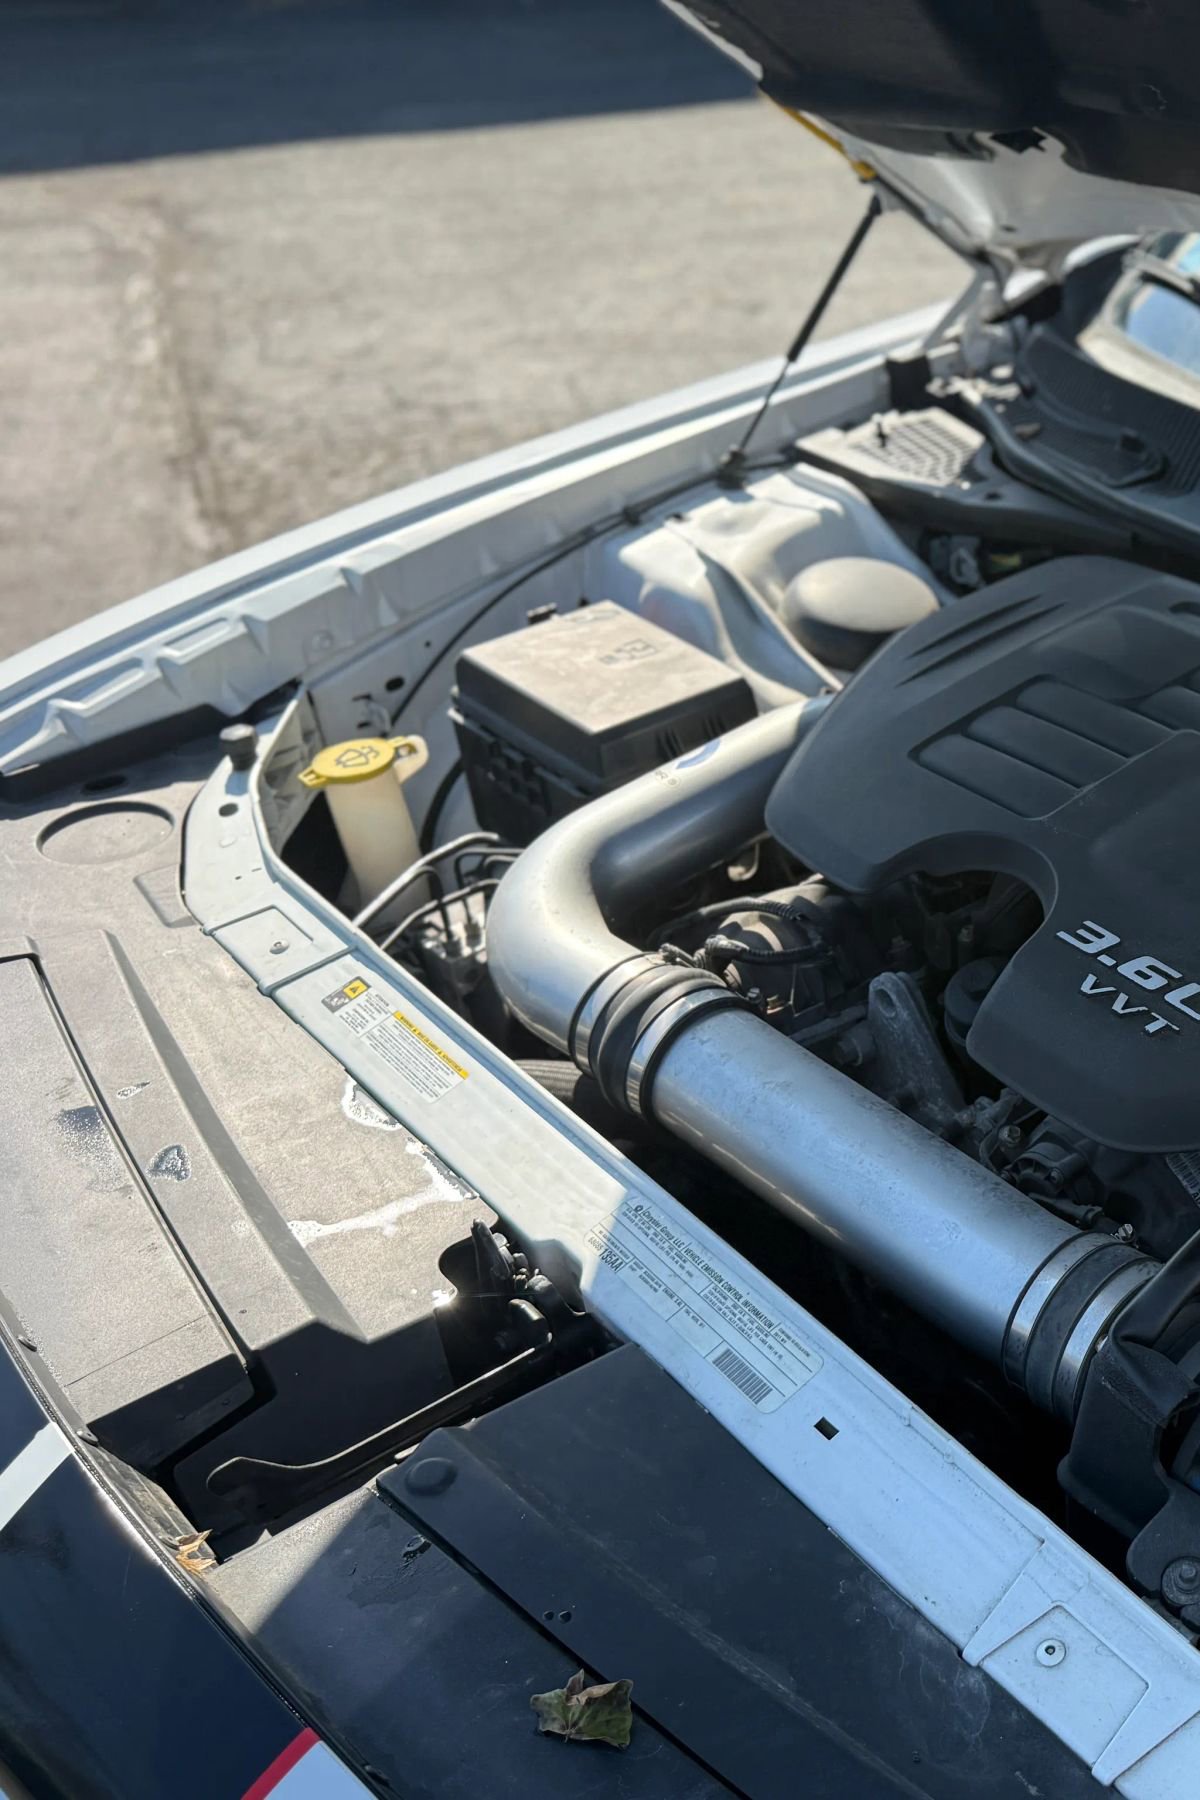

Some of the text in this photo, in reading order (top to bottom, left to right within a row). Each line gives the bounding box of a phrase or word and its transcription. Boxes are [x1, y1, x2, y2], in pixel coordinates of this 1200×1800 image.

[1080, 973, 1181, 1034] VVT
[599, 1248, 624, 1272] 135AA
[642, 1210, 663, 1231] Chrysler
[660, 1226, 675, 1242] Group
[672, 1236, 685, 1249] LLC
[683, 1247, 705, 1266] VEHICLE
[700, 1262, 726, 1285] EMISSION
[721, 1281, 744, 1302] CONTROL
[741, 1299, 775, 1330] INFORMATION
